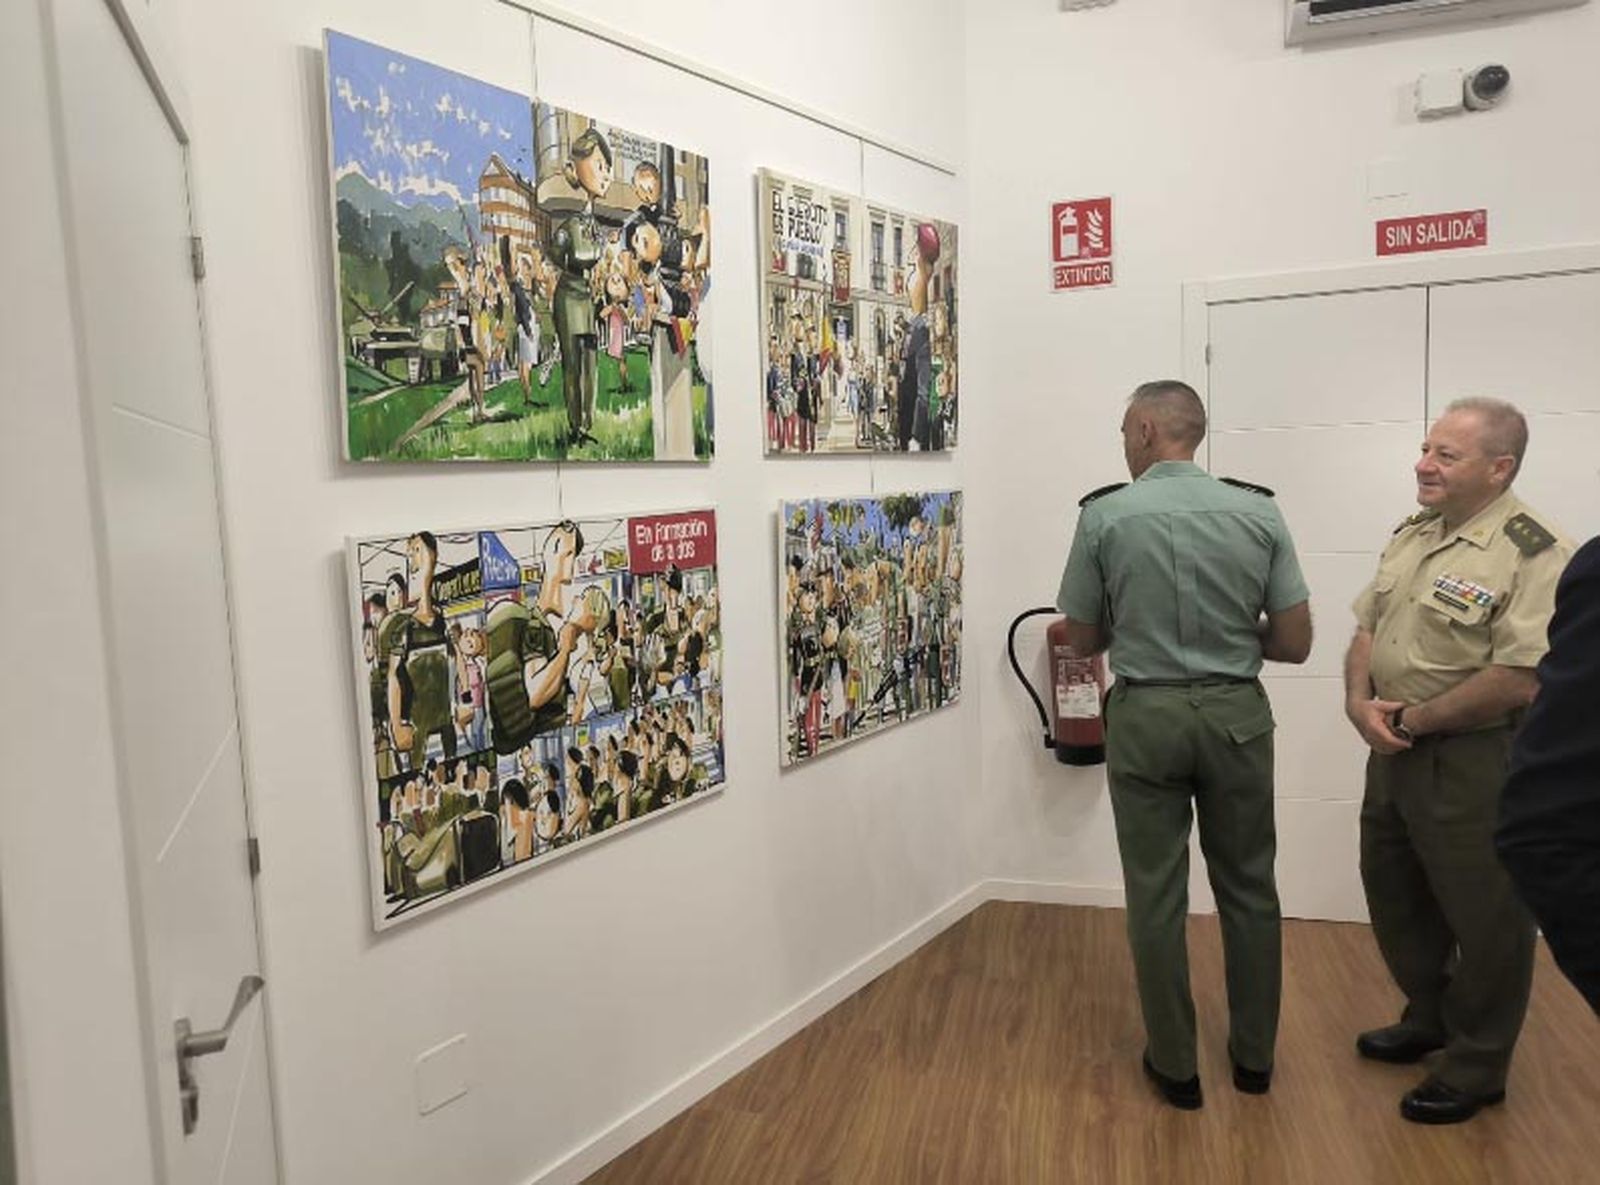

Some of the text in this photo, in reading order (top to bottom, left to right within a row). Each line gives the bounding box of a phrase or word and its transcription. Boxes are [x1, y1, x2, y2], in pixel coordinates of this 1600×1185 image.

[772, 191, 785, 213] EL
[1385, 225, 1412, 248] SIN
[1415, 218, 1476, 244] SALIDA
[1055, 264, 1111, 286] EXTINTOR
[635, 525, 653, 545] En
